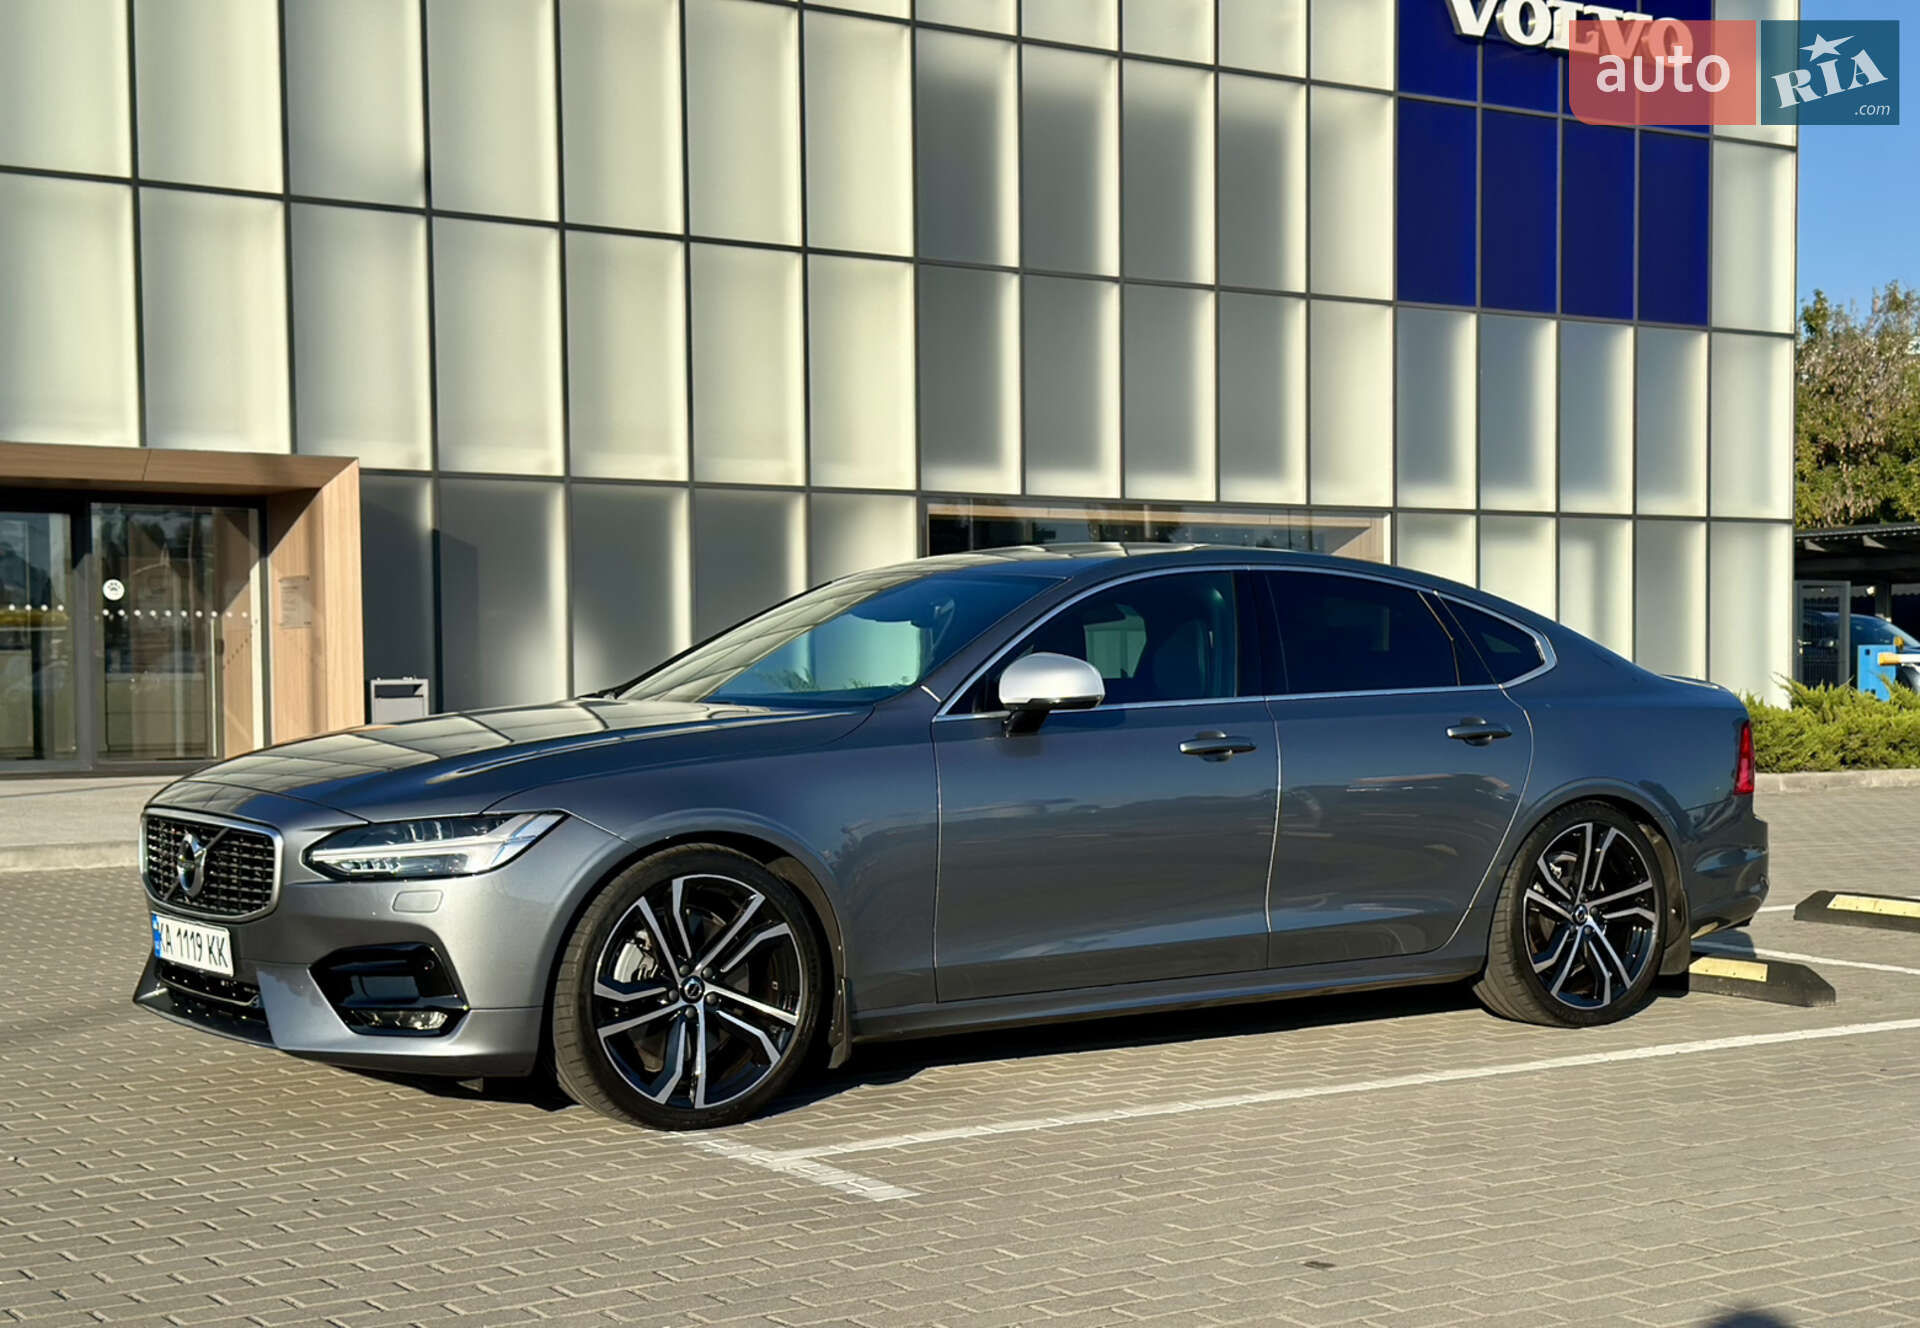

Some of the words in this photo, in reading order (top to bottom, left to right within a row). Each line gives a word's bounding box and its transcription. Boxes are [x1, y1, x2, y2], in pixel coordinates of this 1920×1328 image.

[1446, 0, 1694, 67] VOLVO
[176, 927, 203, 962] 1119
[206, 933, 229, 968] KK
